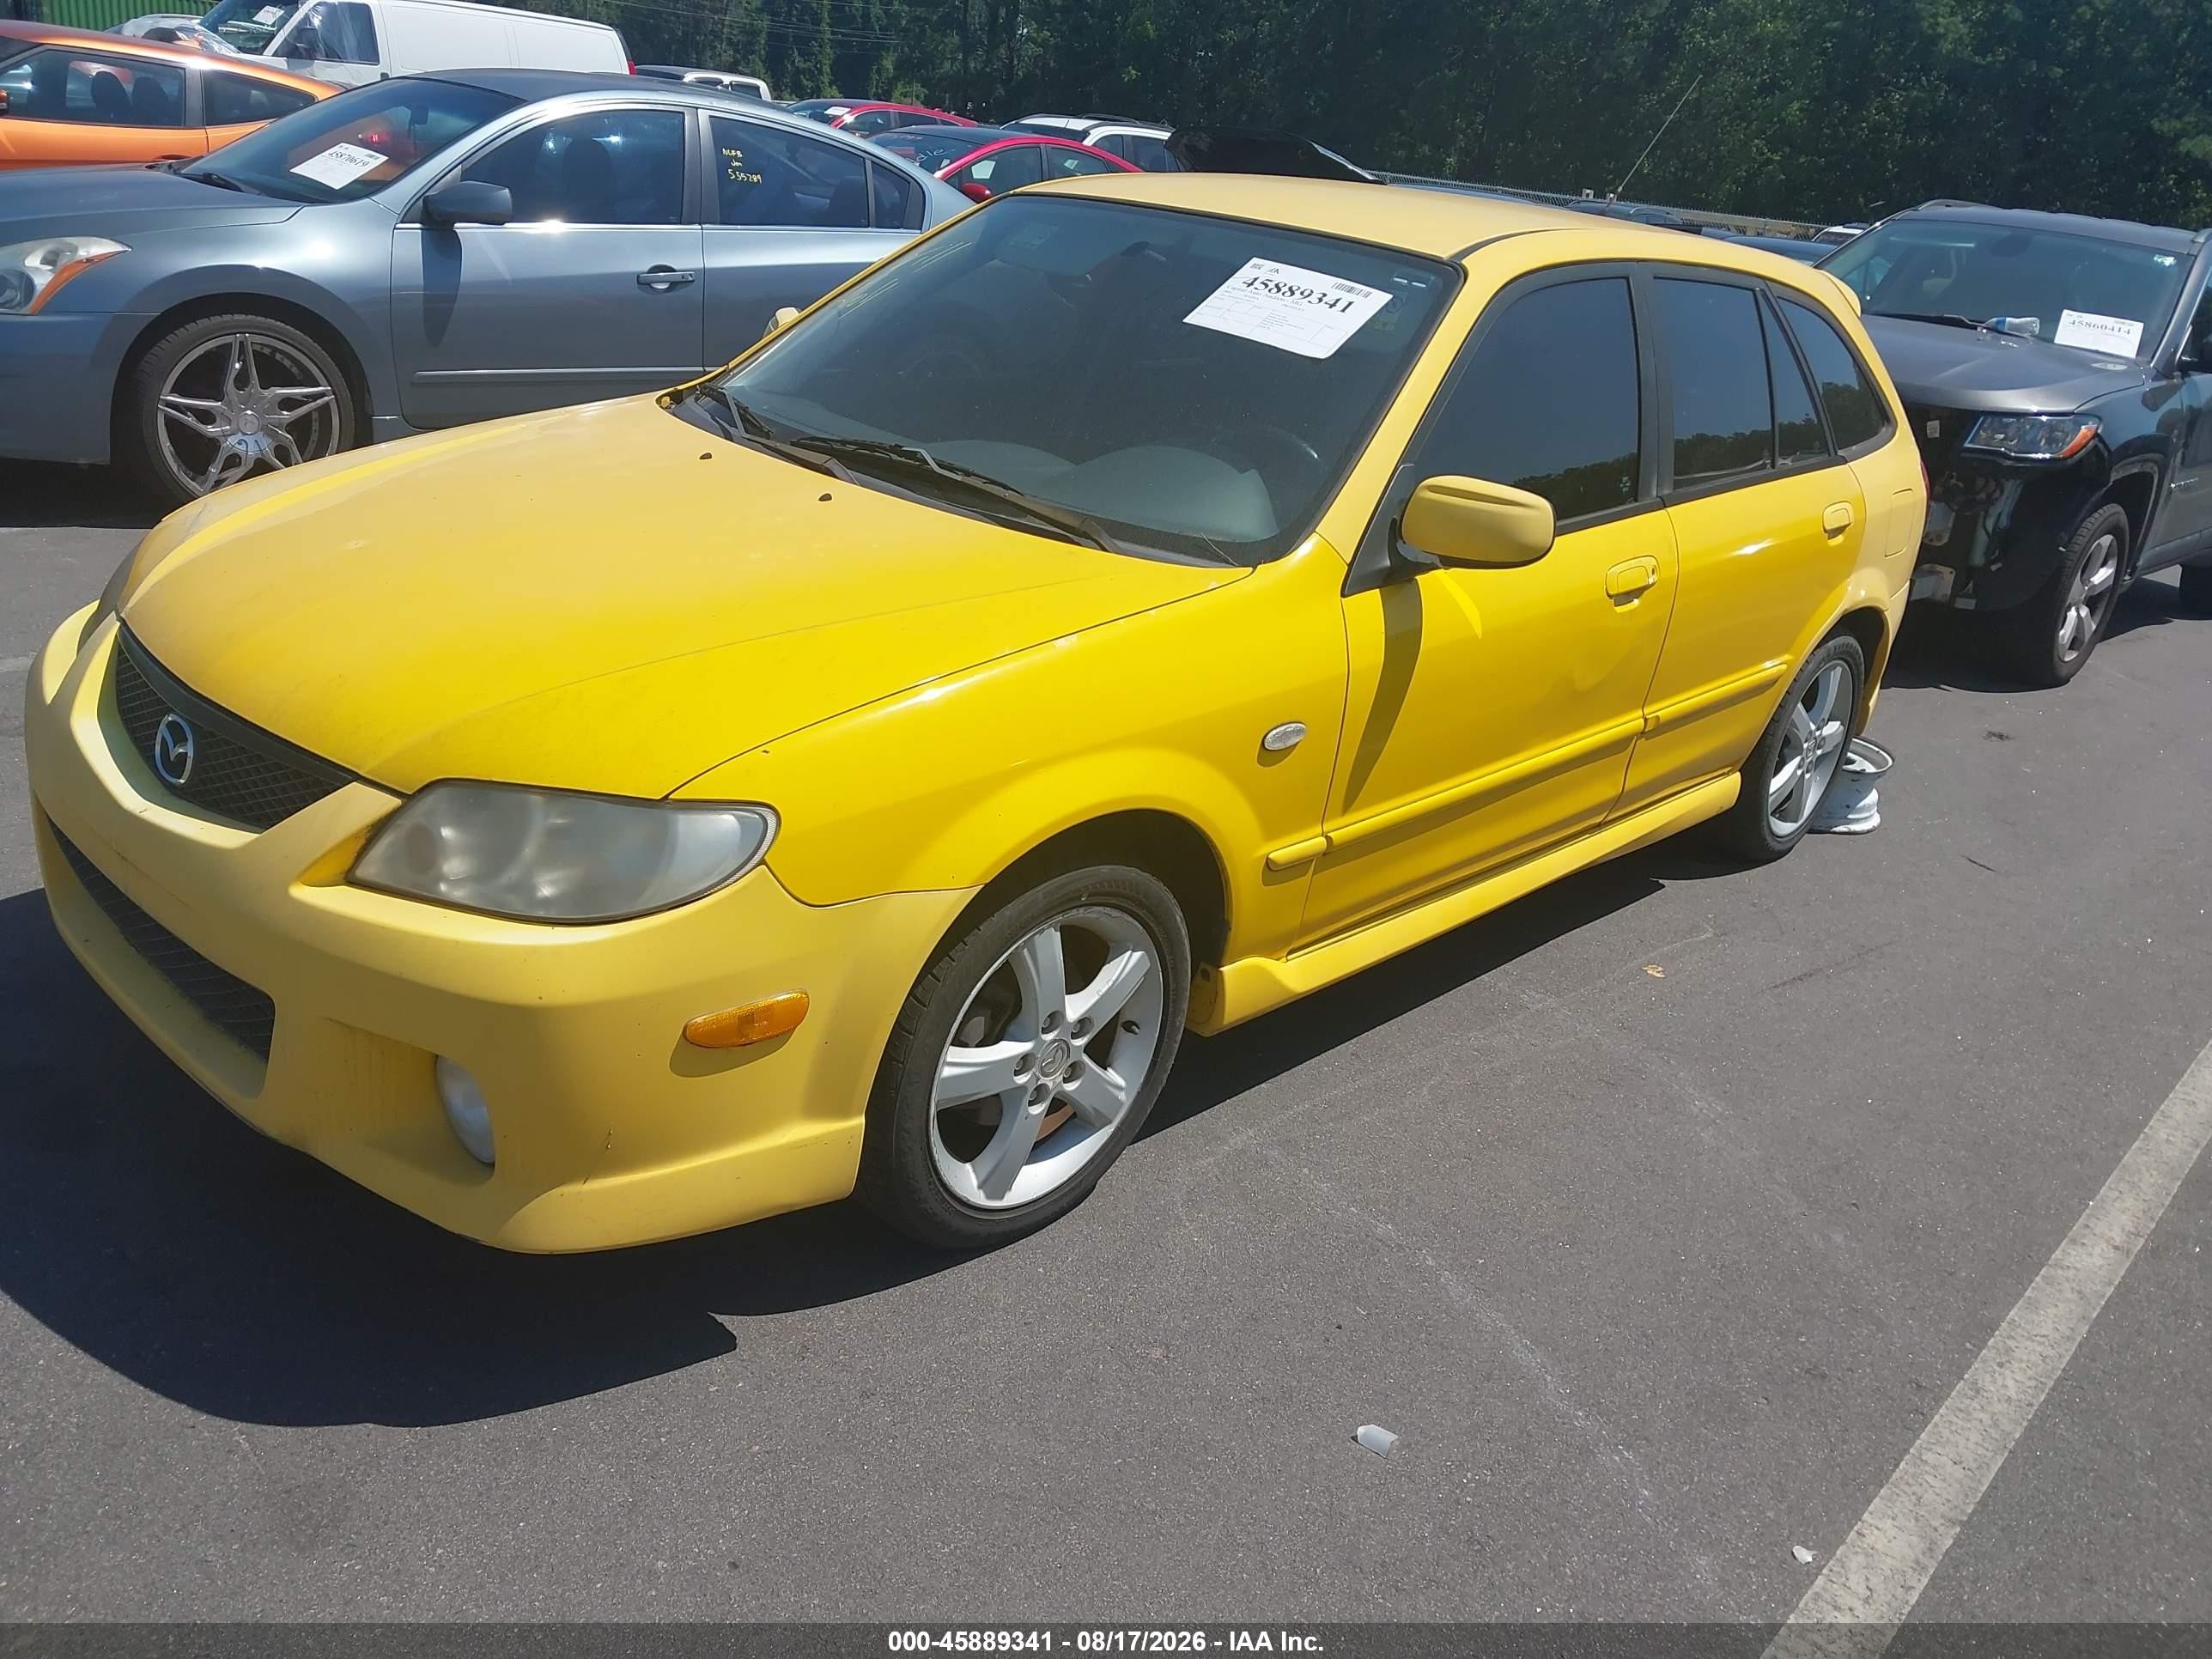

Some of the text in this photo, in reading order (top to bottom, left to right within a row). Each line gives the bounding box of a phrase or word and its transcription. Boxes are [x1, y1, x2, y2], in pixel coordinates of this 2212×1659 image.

[728, 168, 763, 185] 555289
[1242, 276, 1356, 313] 45889341
[2069, 319, 2130, 335] 45860414
